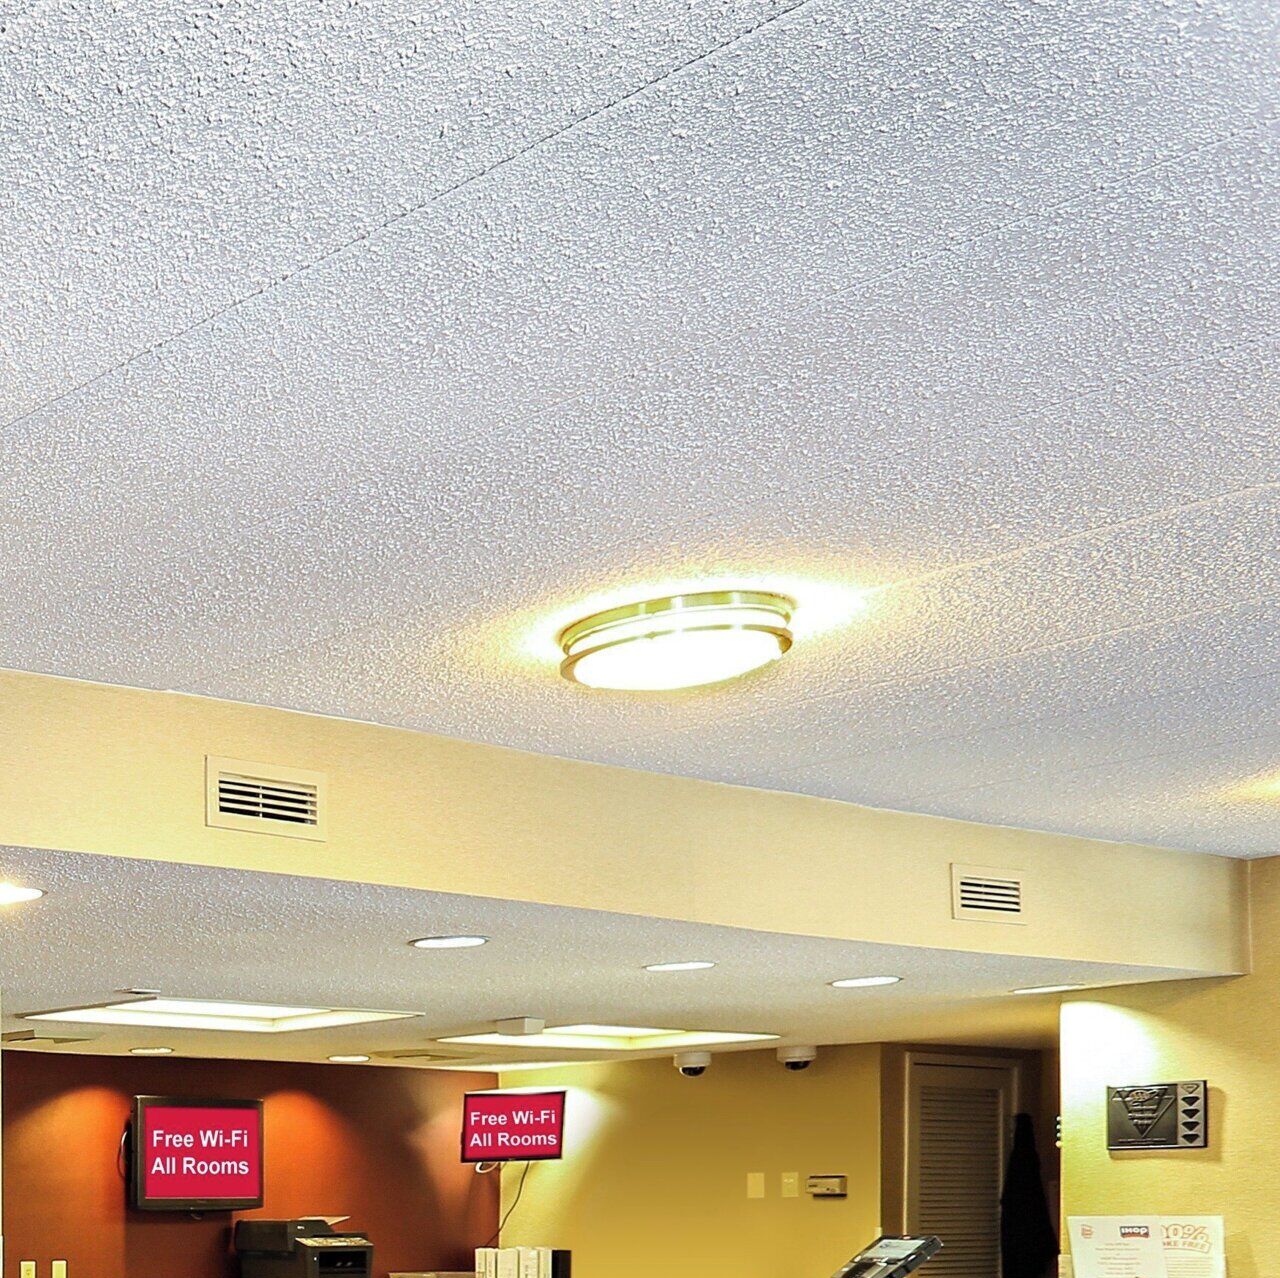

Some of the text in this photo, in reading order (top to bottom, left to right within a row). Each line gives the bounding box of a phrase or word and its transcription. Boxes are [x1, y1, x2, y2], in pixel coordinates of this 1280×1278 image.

[470, 1110, 556, 1126] Free Wi-Fi
[152, 1129, 248, 1148] Free Wi-Fi
[470, 1132, 558, 1147] All Rooms
[151, 1156, 250, 1175] All Rooms
